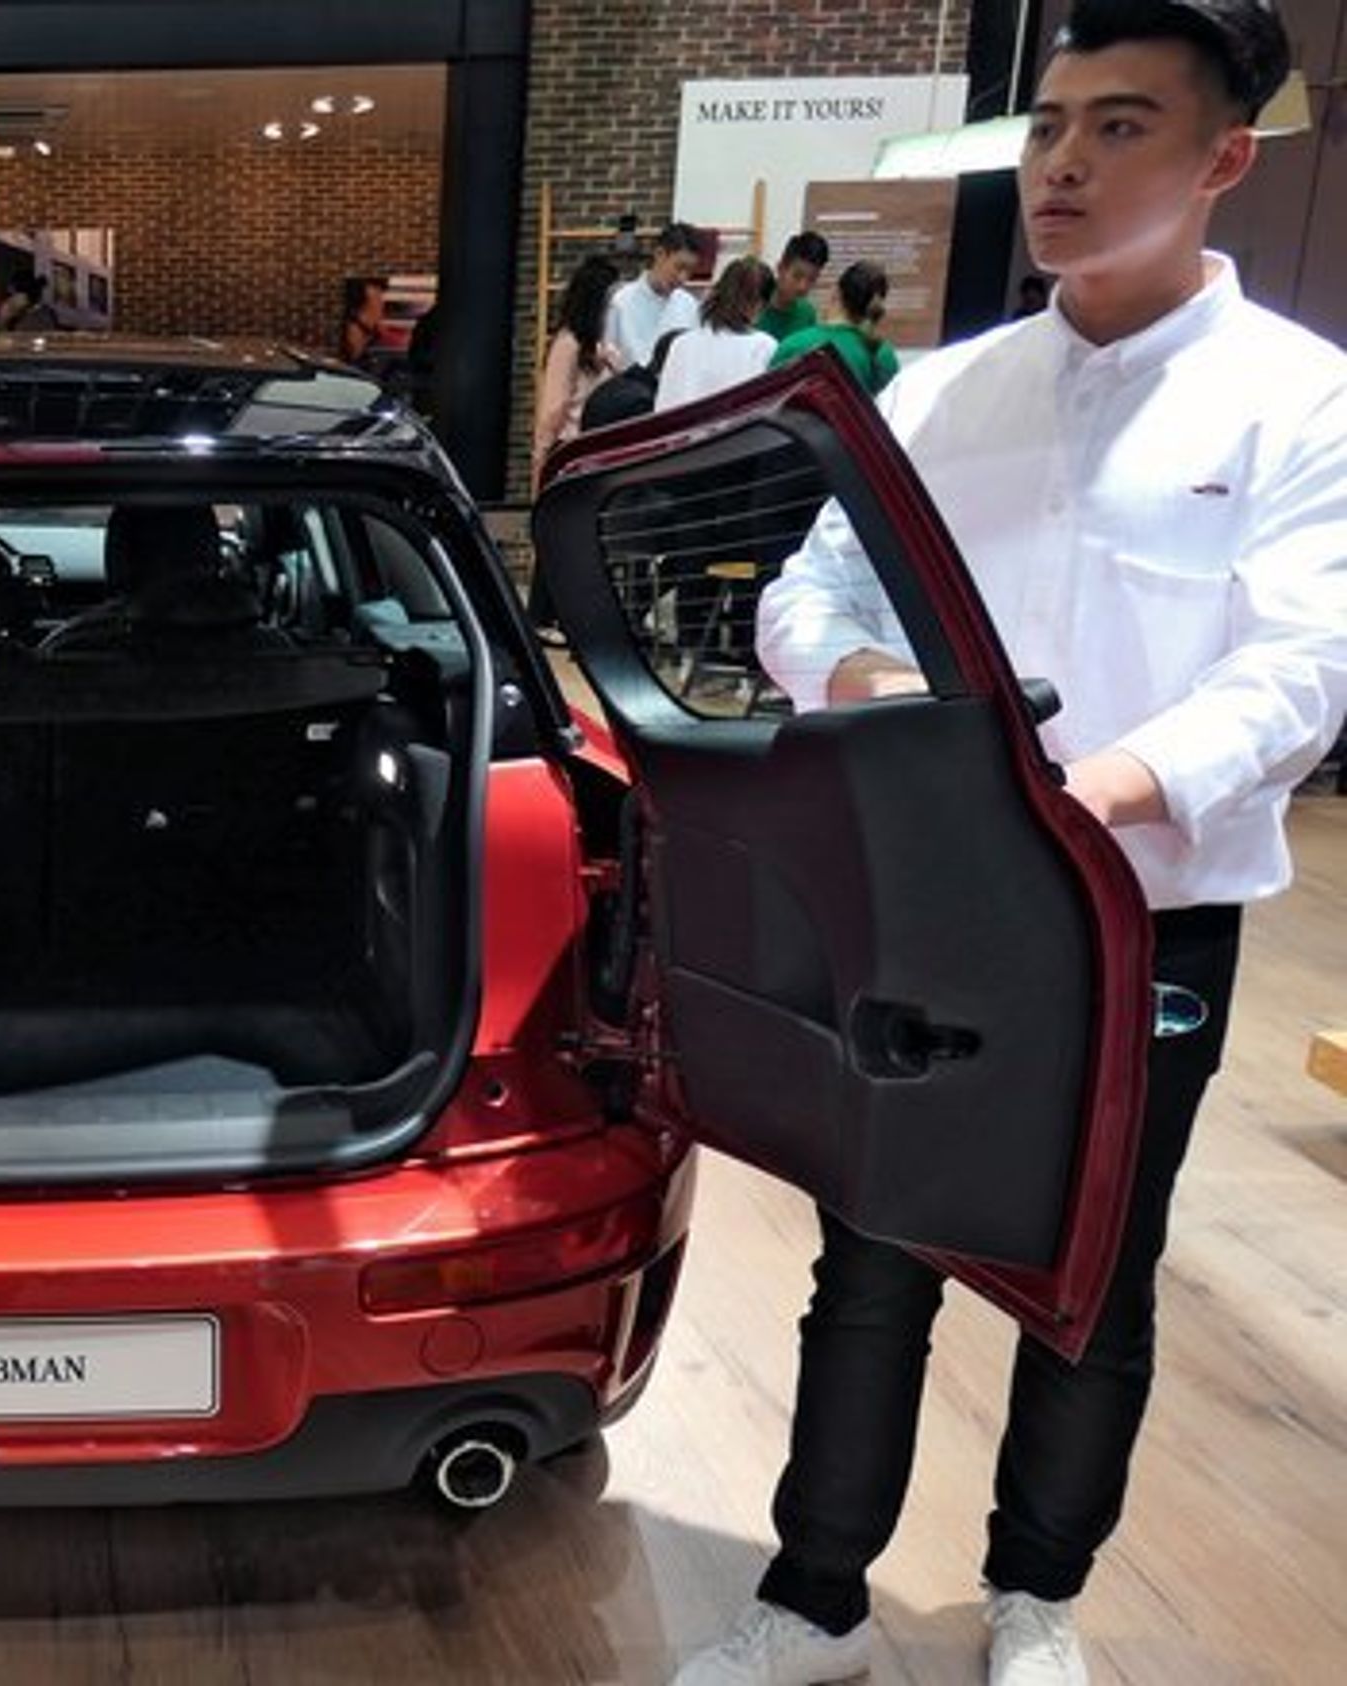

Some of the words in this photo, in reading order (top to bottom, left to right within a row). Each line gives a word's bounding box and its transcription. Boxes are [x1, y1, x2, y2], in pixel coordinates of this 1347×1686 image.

[696, 101, 768, 122] MAKE
[772, 100, 798, 121] IT
[802, 97, 885, 120] YOURS!
